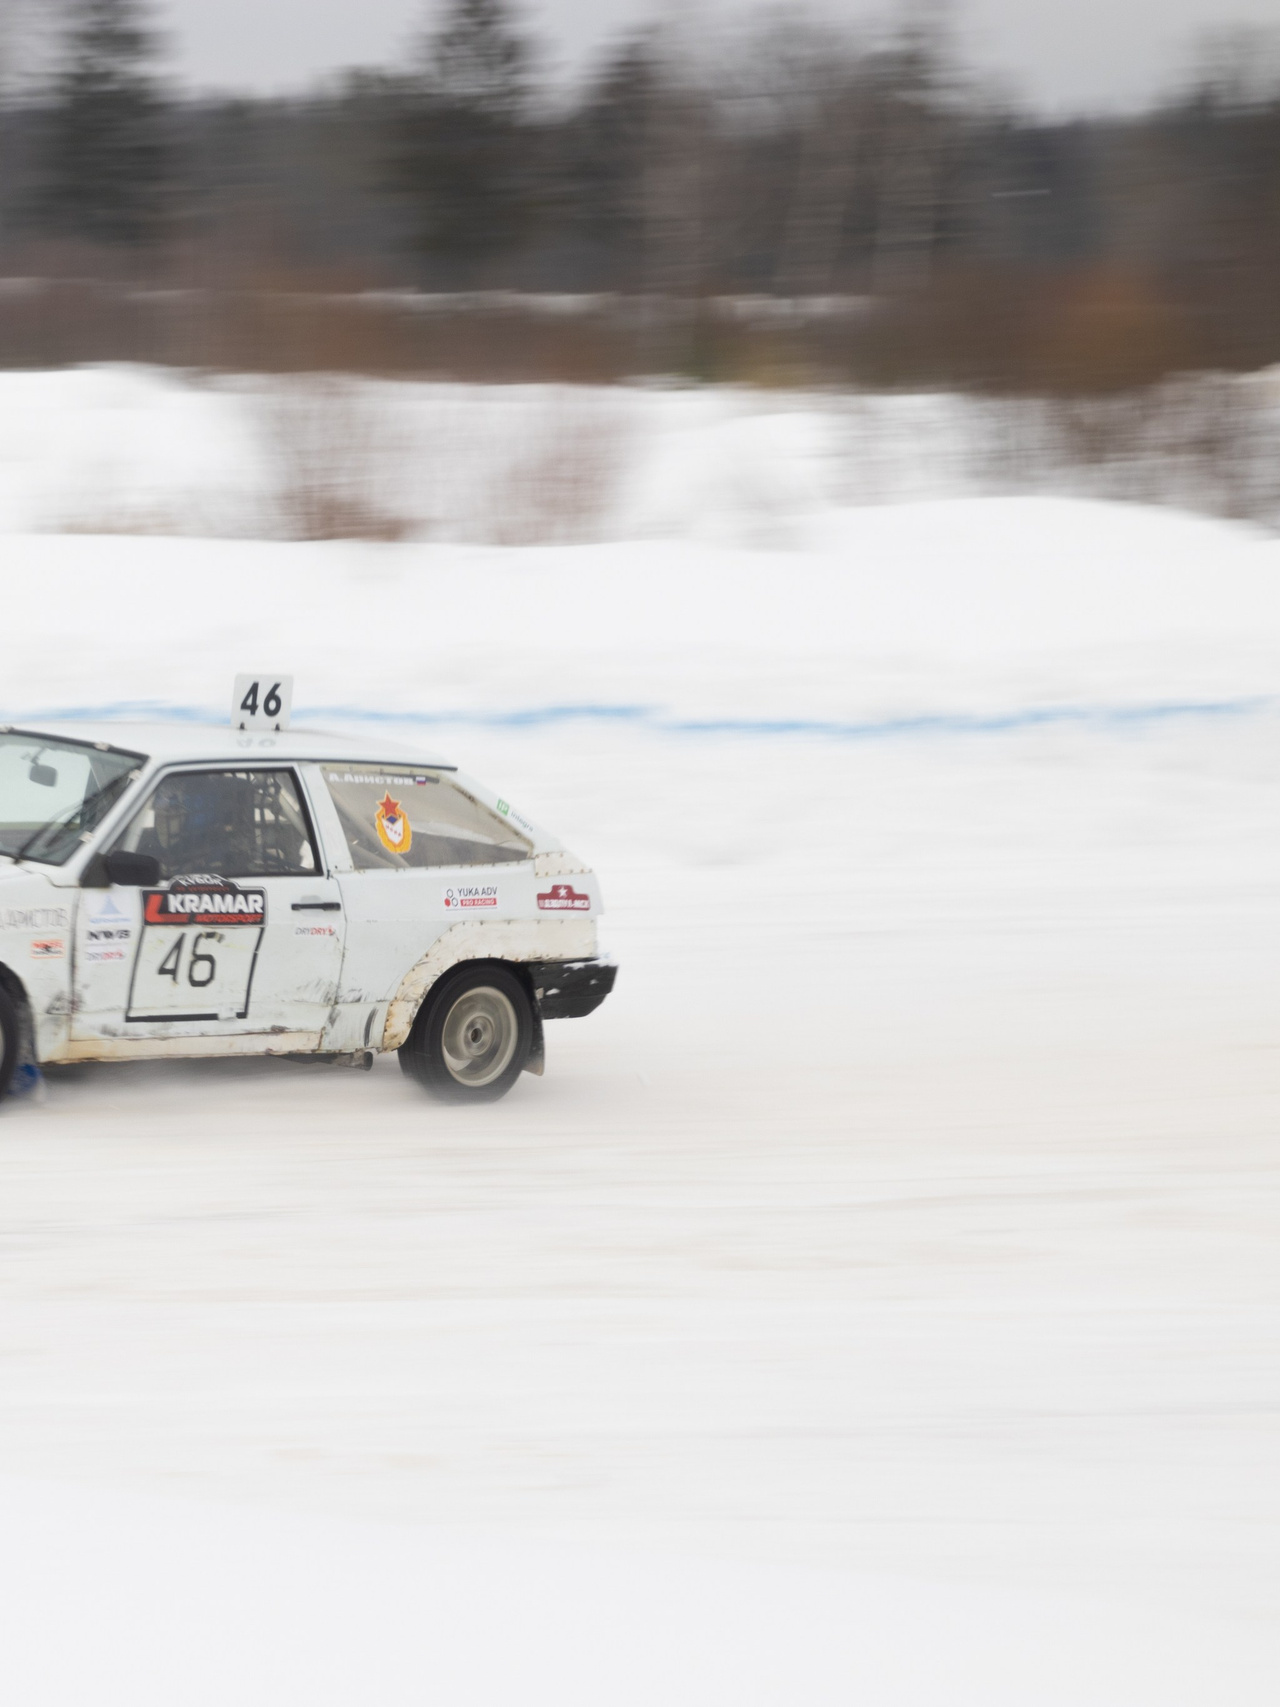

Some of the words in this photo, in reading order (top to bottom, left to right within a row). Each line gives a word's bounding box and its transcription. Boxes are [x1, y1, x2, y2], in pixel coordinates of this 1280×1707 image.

[240, 681, 282, 718] 46
[457, 888, 480, 898] YUKA
[481, 886, 498, 897] ADV
[462, 899, 474, 907] PRO
[475, 898, 495, 906] RACING
[166, 893, 264, 914] KRAMAR
[157, 931, 223, 988] 46
